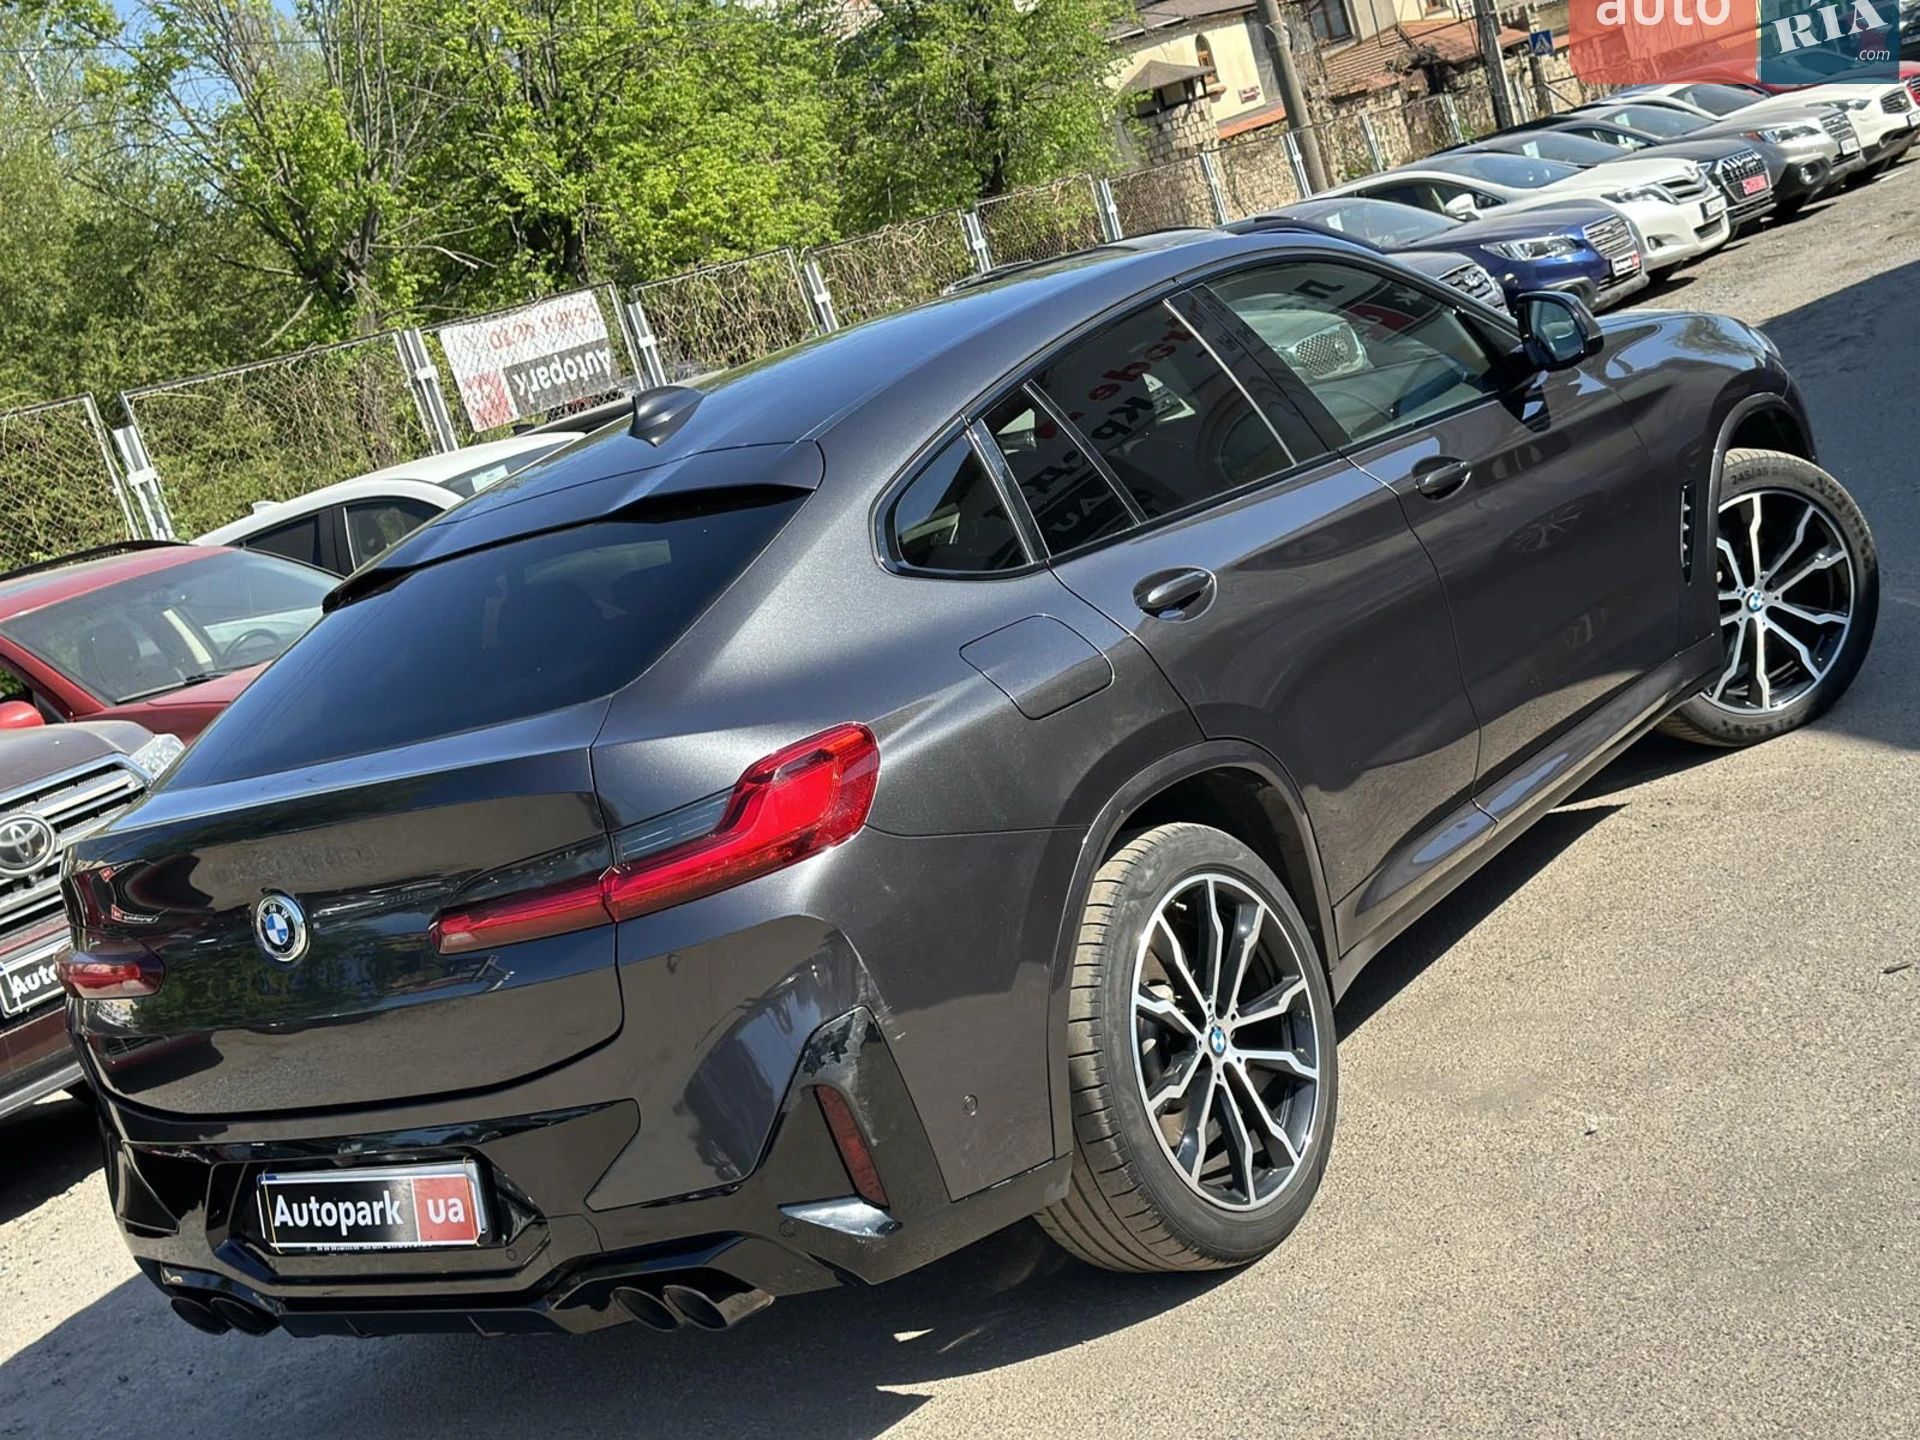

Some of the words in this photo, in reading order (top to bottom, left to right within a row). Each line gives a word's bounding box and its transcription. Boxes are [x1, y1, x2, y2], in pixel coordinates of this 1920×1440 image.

[512, 347, 611, 404] Autopark
[274, 1190, 404, 1236] Autopark
[427, 1196, 465, 1224] ua
